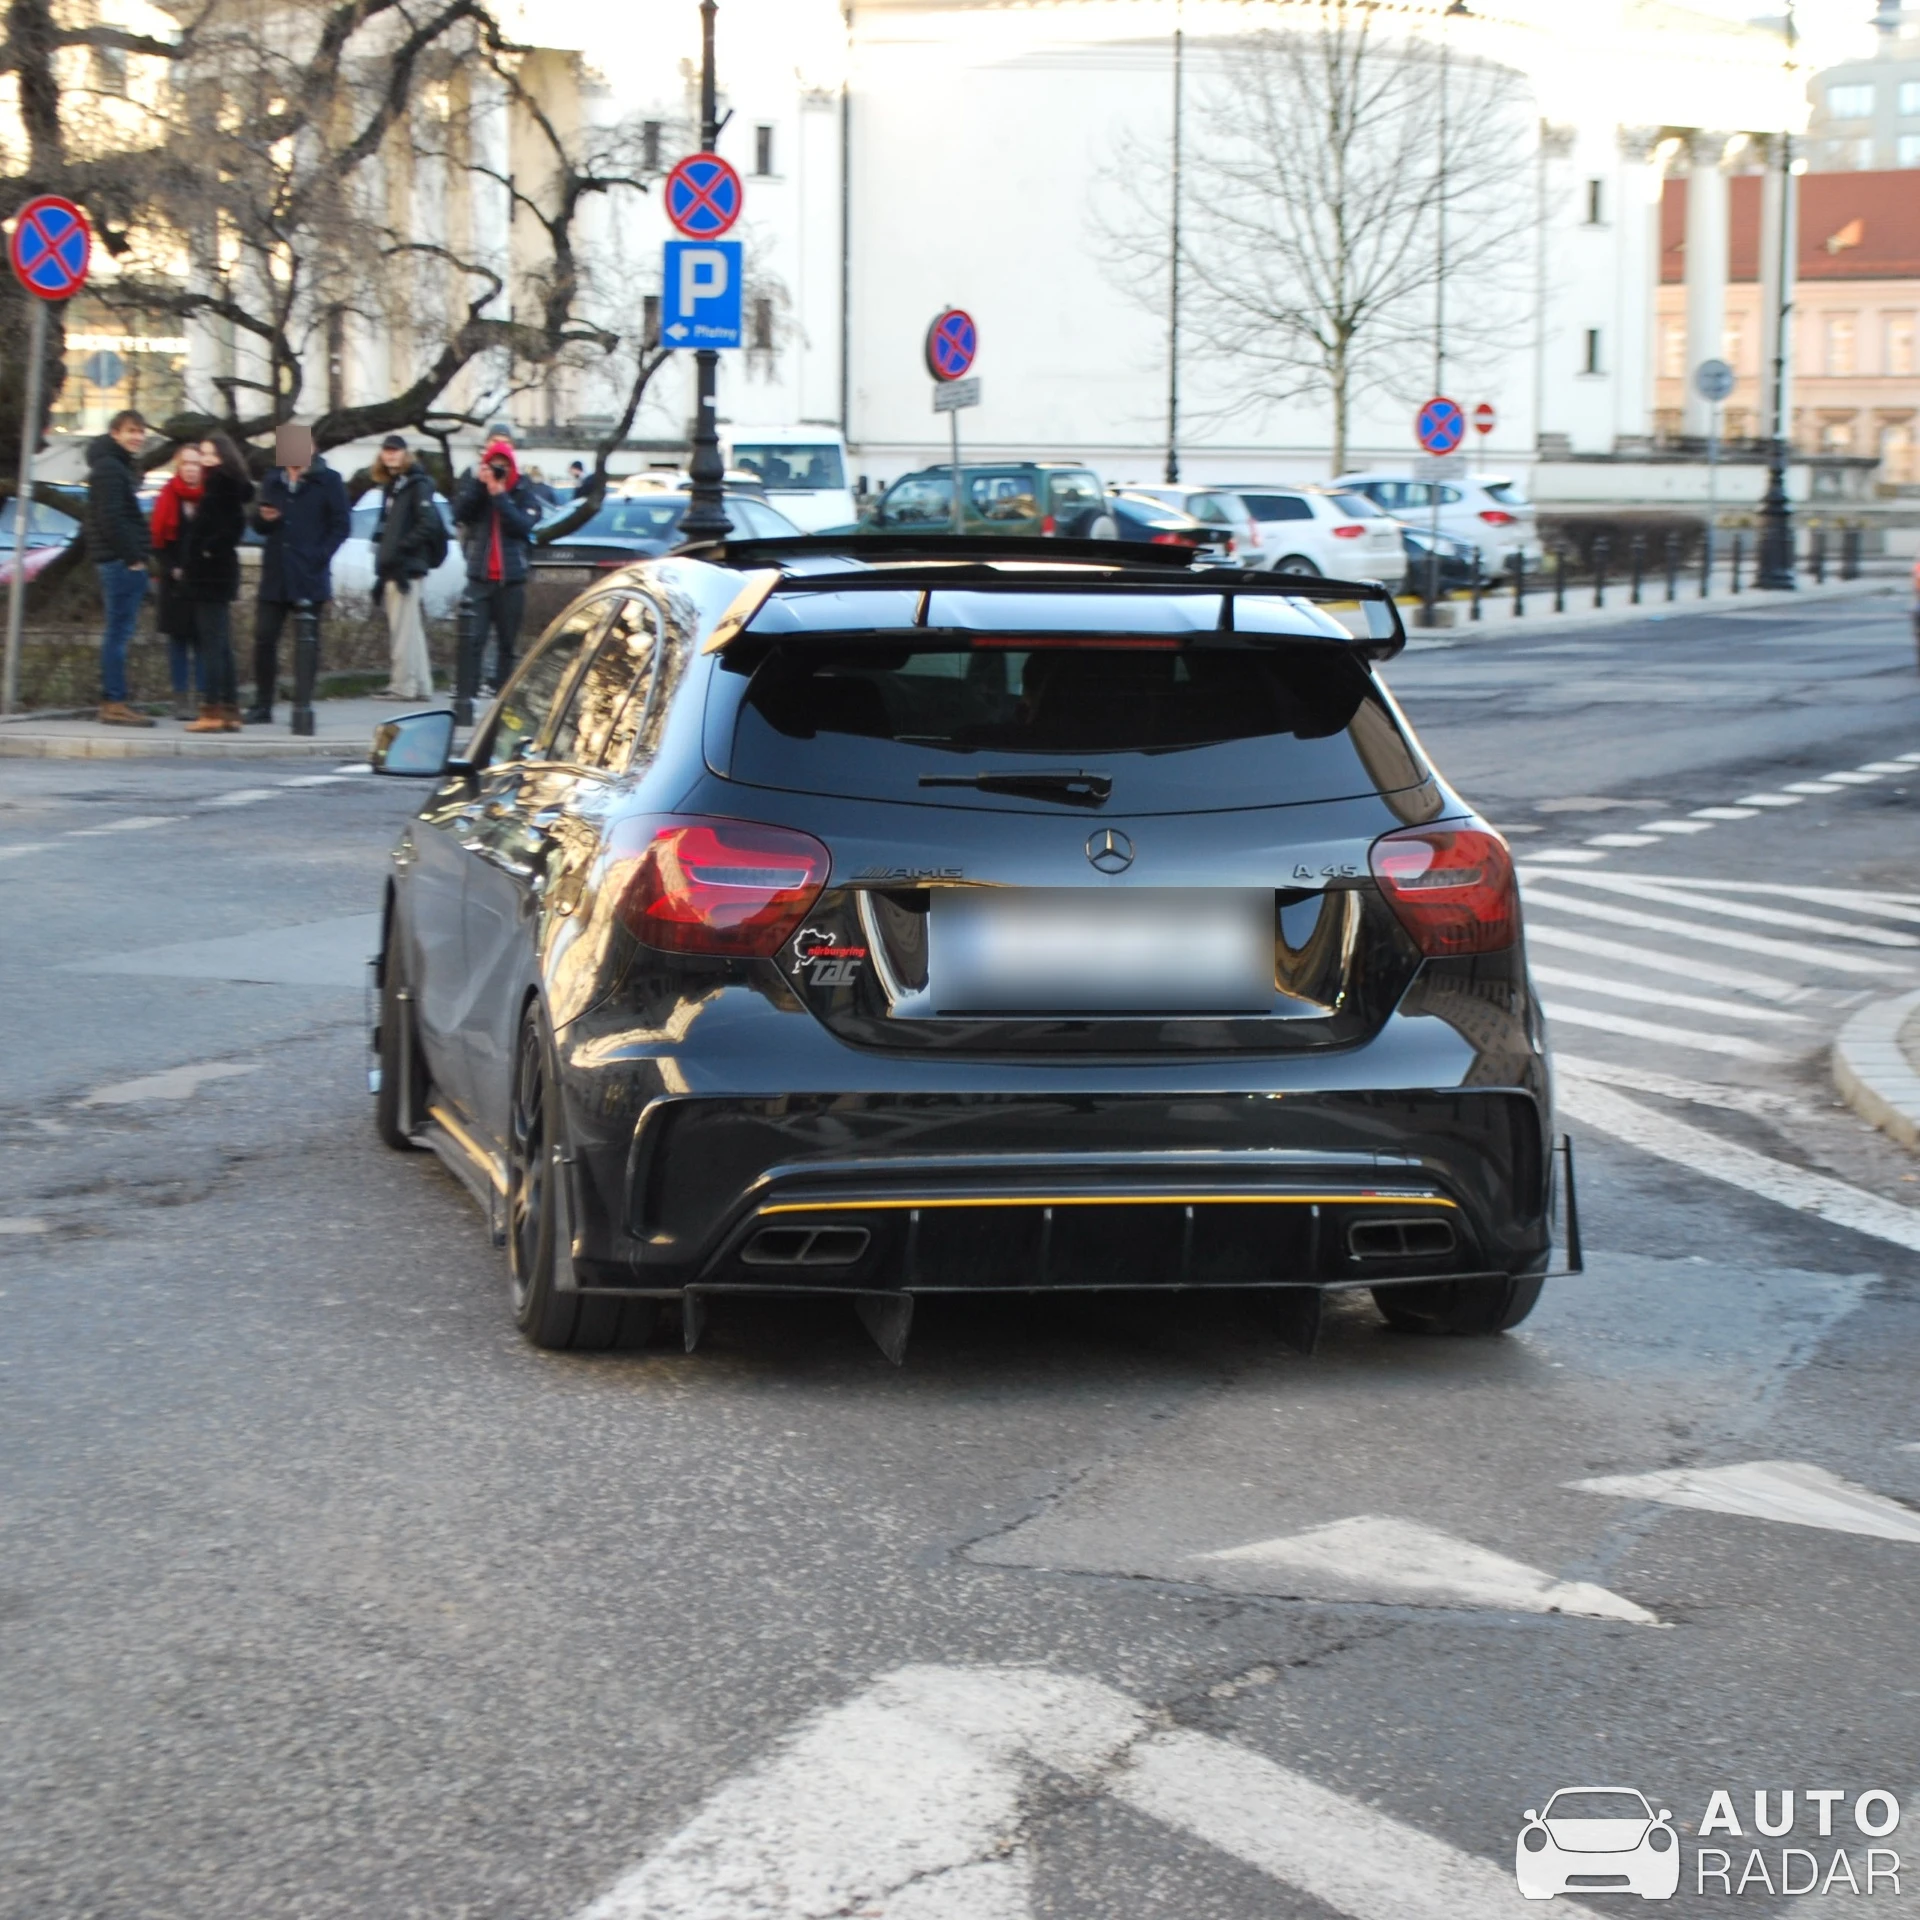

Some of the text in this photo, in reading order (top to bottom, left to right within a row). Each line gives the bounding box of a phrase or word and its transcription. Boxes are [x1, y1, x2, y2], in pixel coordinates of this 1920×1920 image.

[679, 249, 728, 317] P
[886, 867, 963, 878] AMG
[1293, 864, 1358, 878] A 45
